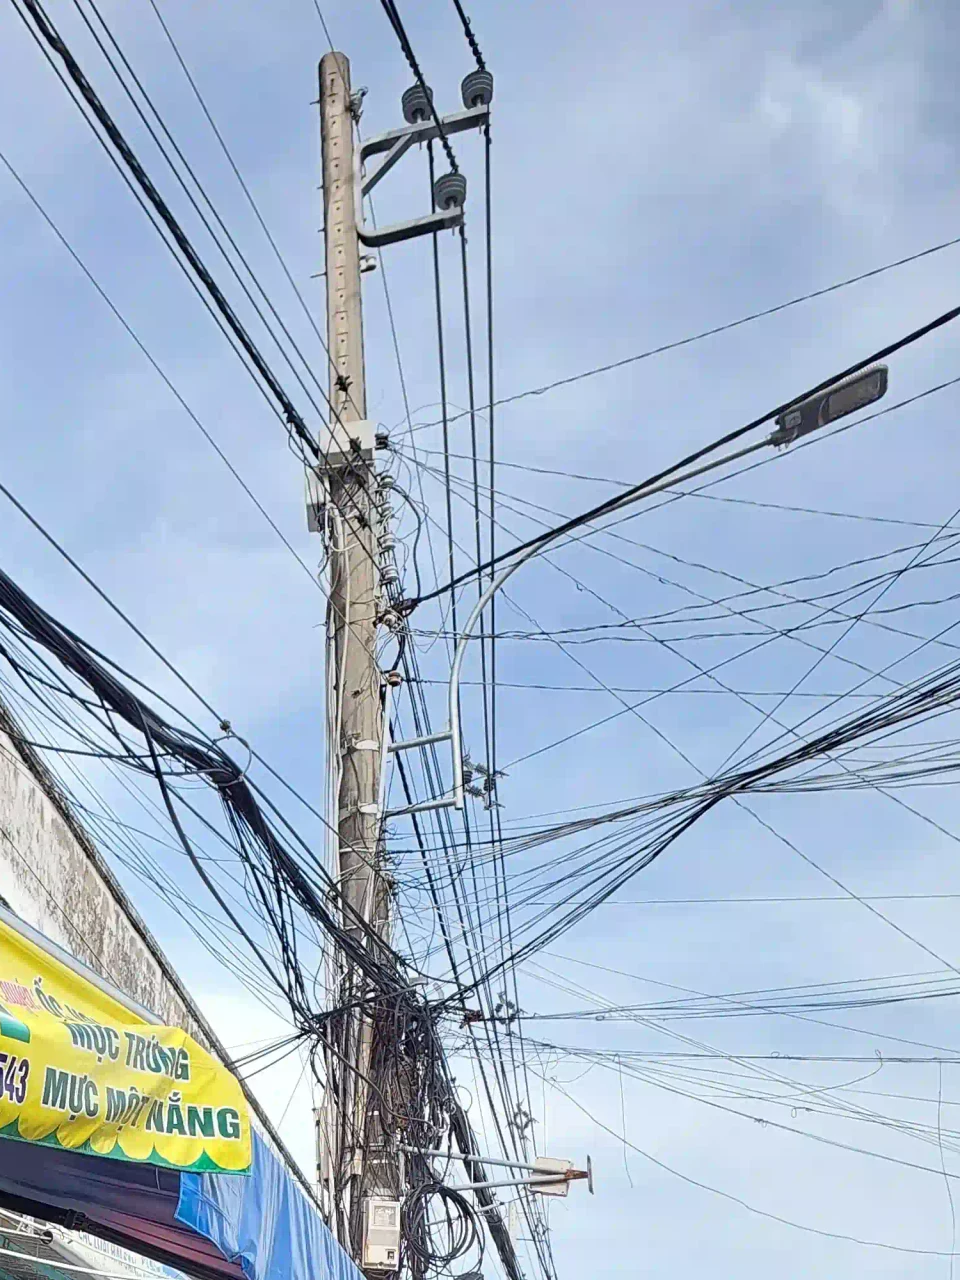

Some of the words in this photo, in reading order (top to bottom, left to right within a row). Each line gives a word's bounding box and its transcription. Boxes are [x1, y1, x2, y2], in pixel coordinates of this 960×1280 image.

[42, 1067, 99, 1120] MỰC
[105, 1086, 149, 1131] MỘT
[145, 1091, 241, 1140] NẮNG
